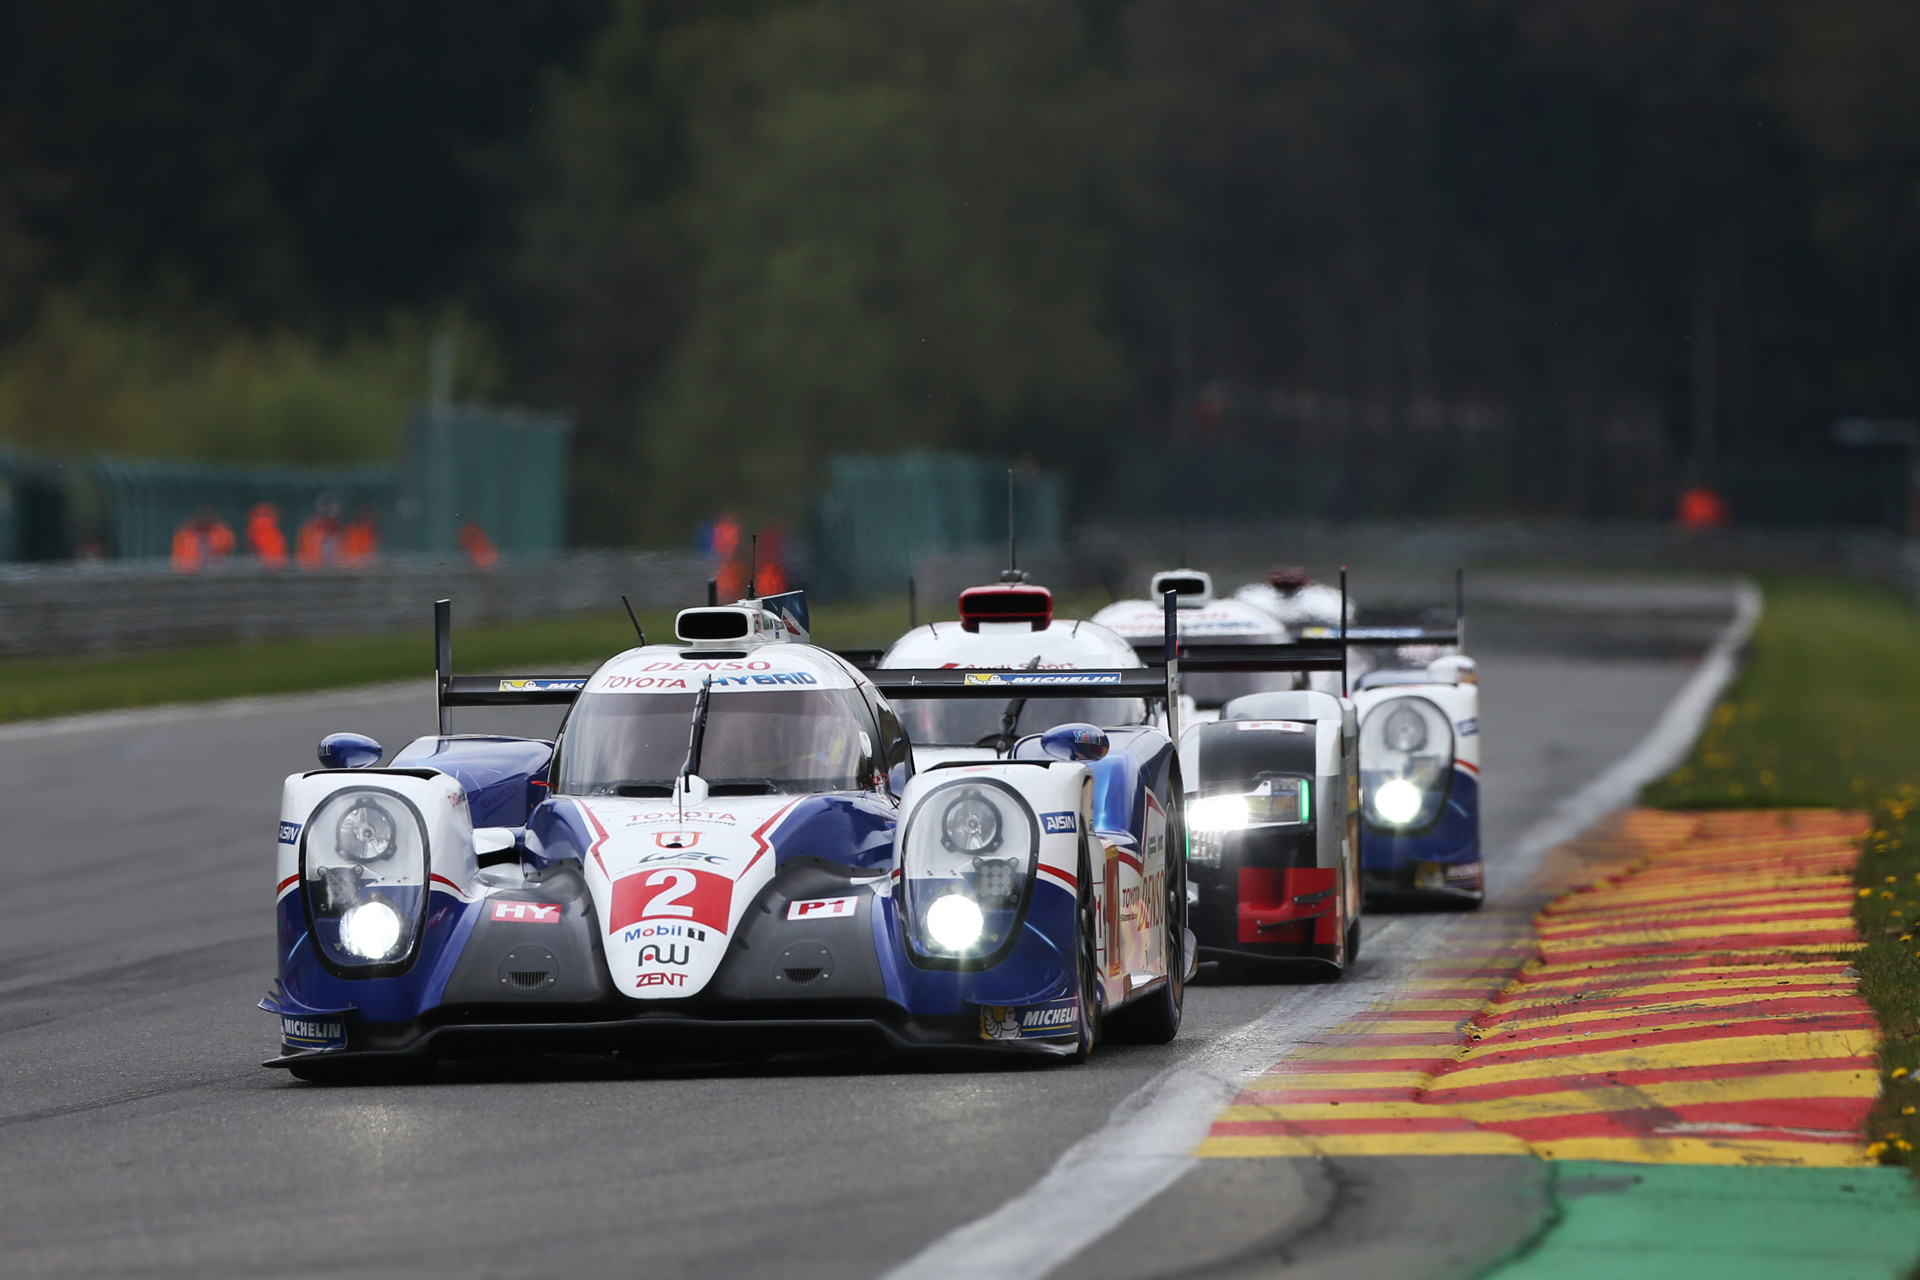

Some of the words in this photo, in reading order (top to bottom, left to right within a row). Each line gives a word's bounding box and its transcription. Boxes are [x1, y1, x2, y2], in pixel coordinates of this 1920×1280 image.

[640, 660, 772, 673] DENSO
[601, 675, 688, 689] TOYOTA
[702, 671, 819, 687] HYBRID
[1011, 674, 1119, 685] MICHELIN
[627, 811, 738, 821] TOYOTA
[1046, 815, 1076, 830] AISIN
[641, 868, 697, 918] 2
[494, 903, 557, 920] HY
[797, 899, 846, 916] P1
[624, 925, 682, 943] Mobil
[635, 972, 689, 988] ZENT
[284, 1018, 342, 1038] MICHELIN
